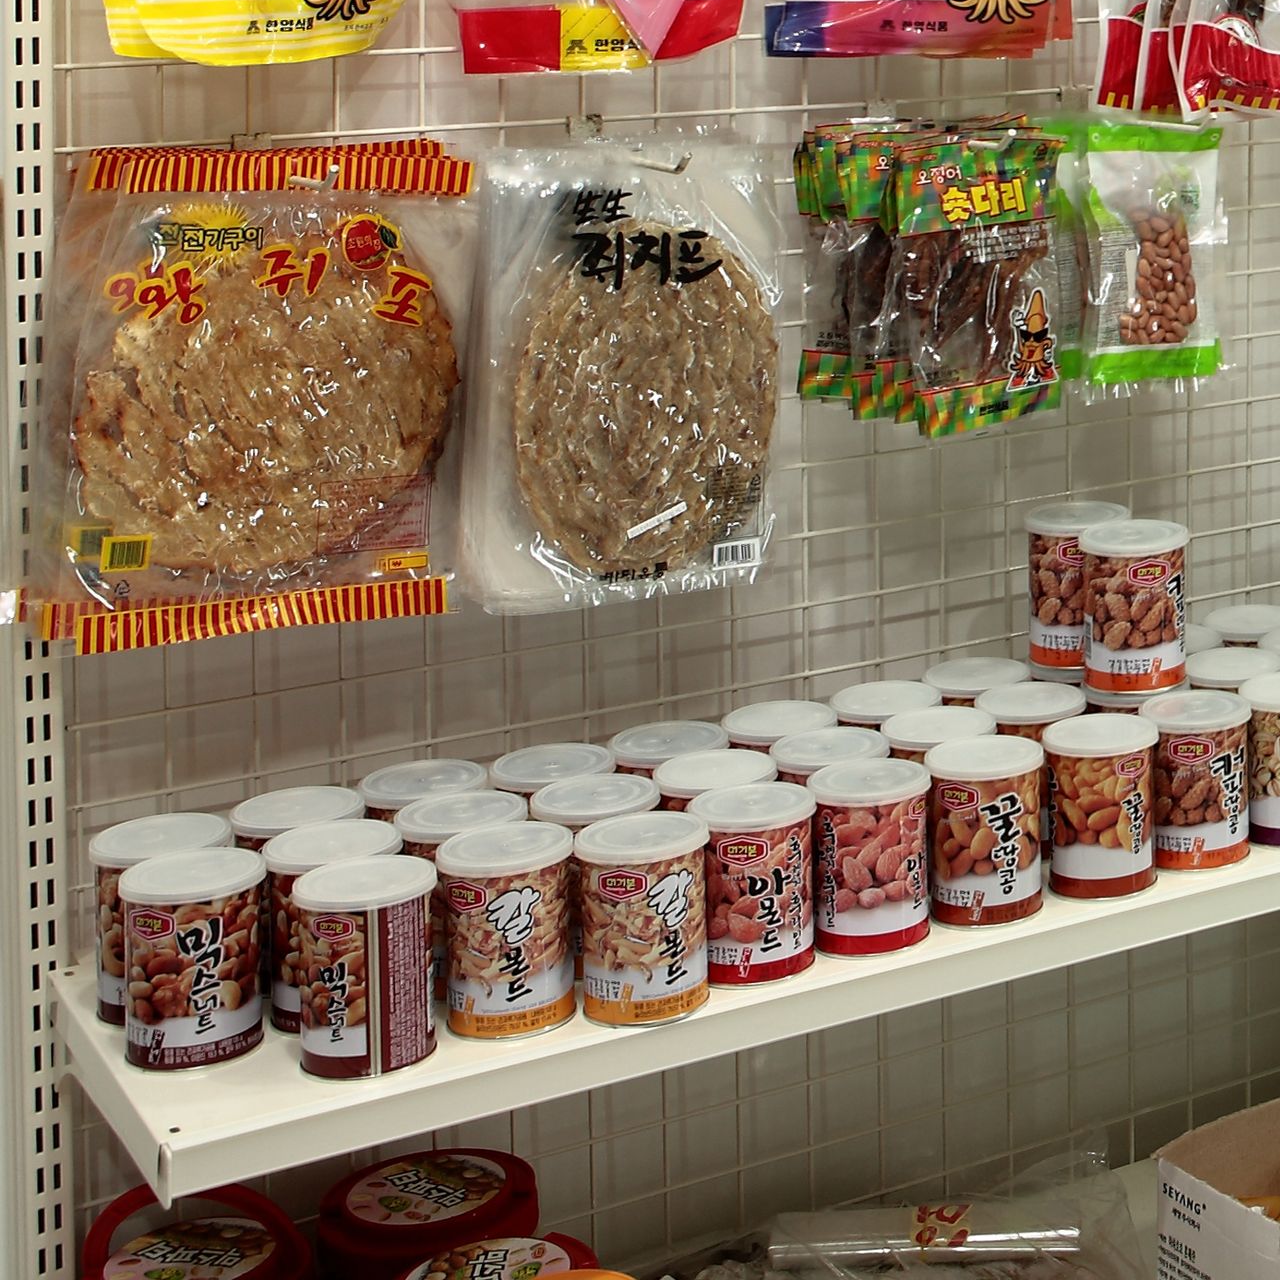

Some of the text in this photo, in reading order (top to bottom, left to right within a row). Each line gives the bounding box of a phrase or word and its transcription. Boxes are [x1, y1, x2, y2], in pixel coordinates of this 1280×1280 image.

[914, 163, 963, 187] 오징어
[181, 225, 264, 251] 전기구이
[1135, 566, 1164, 582] 머거본
[726, 845, 760, 859] 머거본
[979, 793, 1024, 898] 꿀땅콩
[746, 865, 794, 956] 아몬드
[175, 917, 226, 1036] 믹스너트
[316, 962, 351, 1044] 믹스너트
